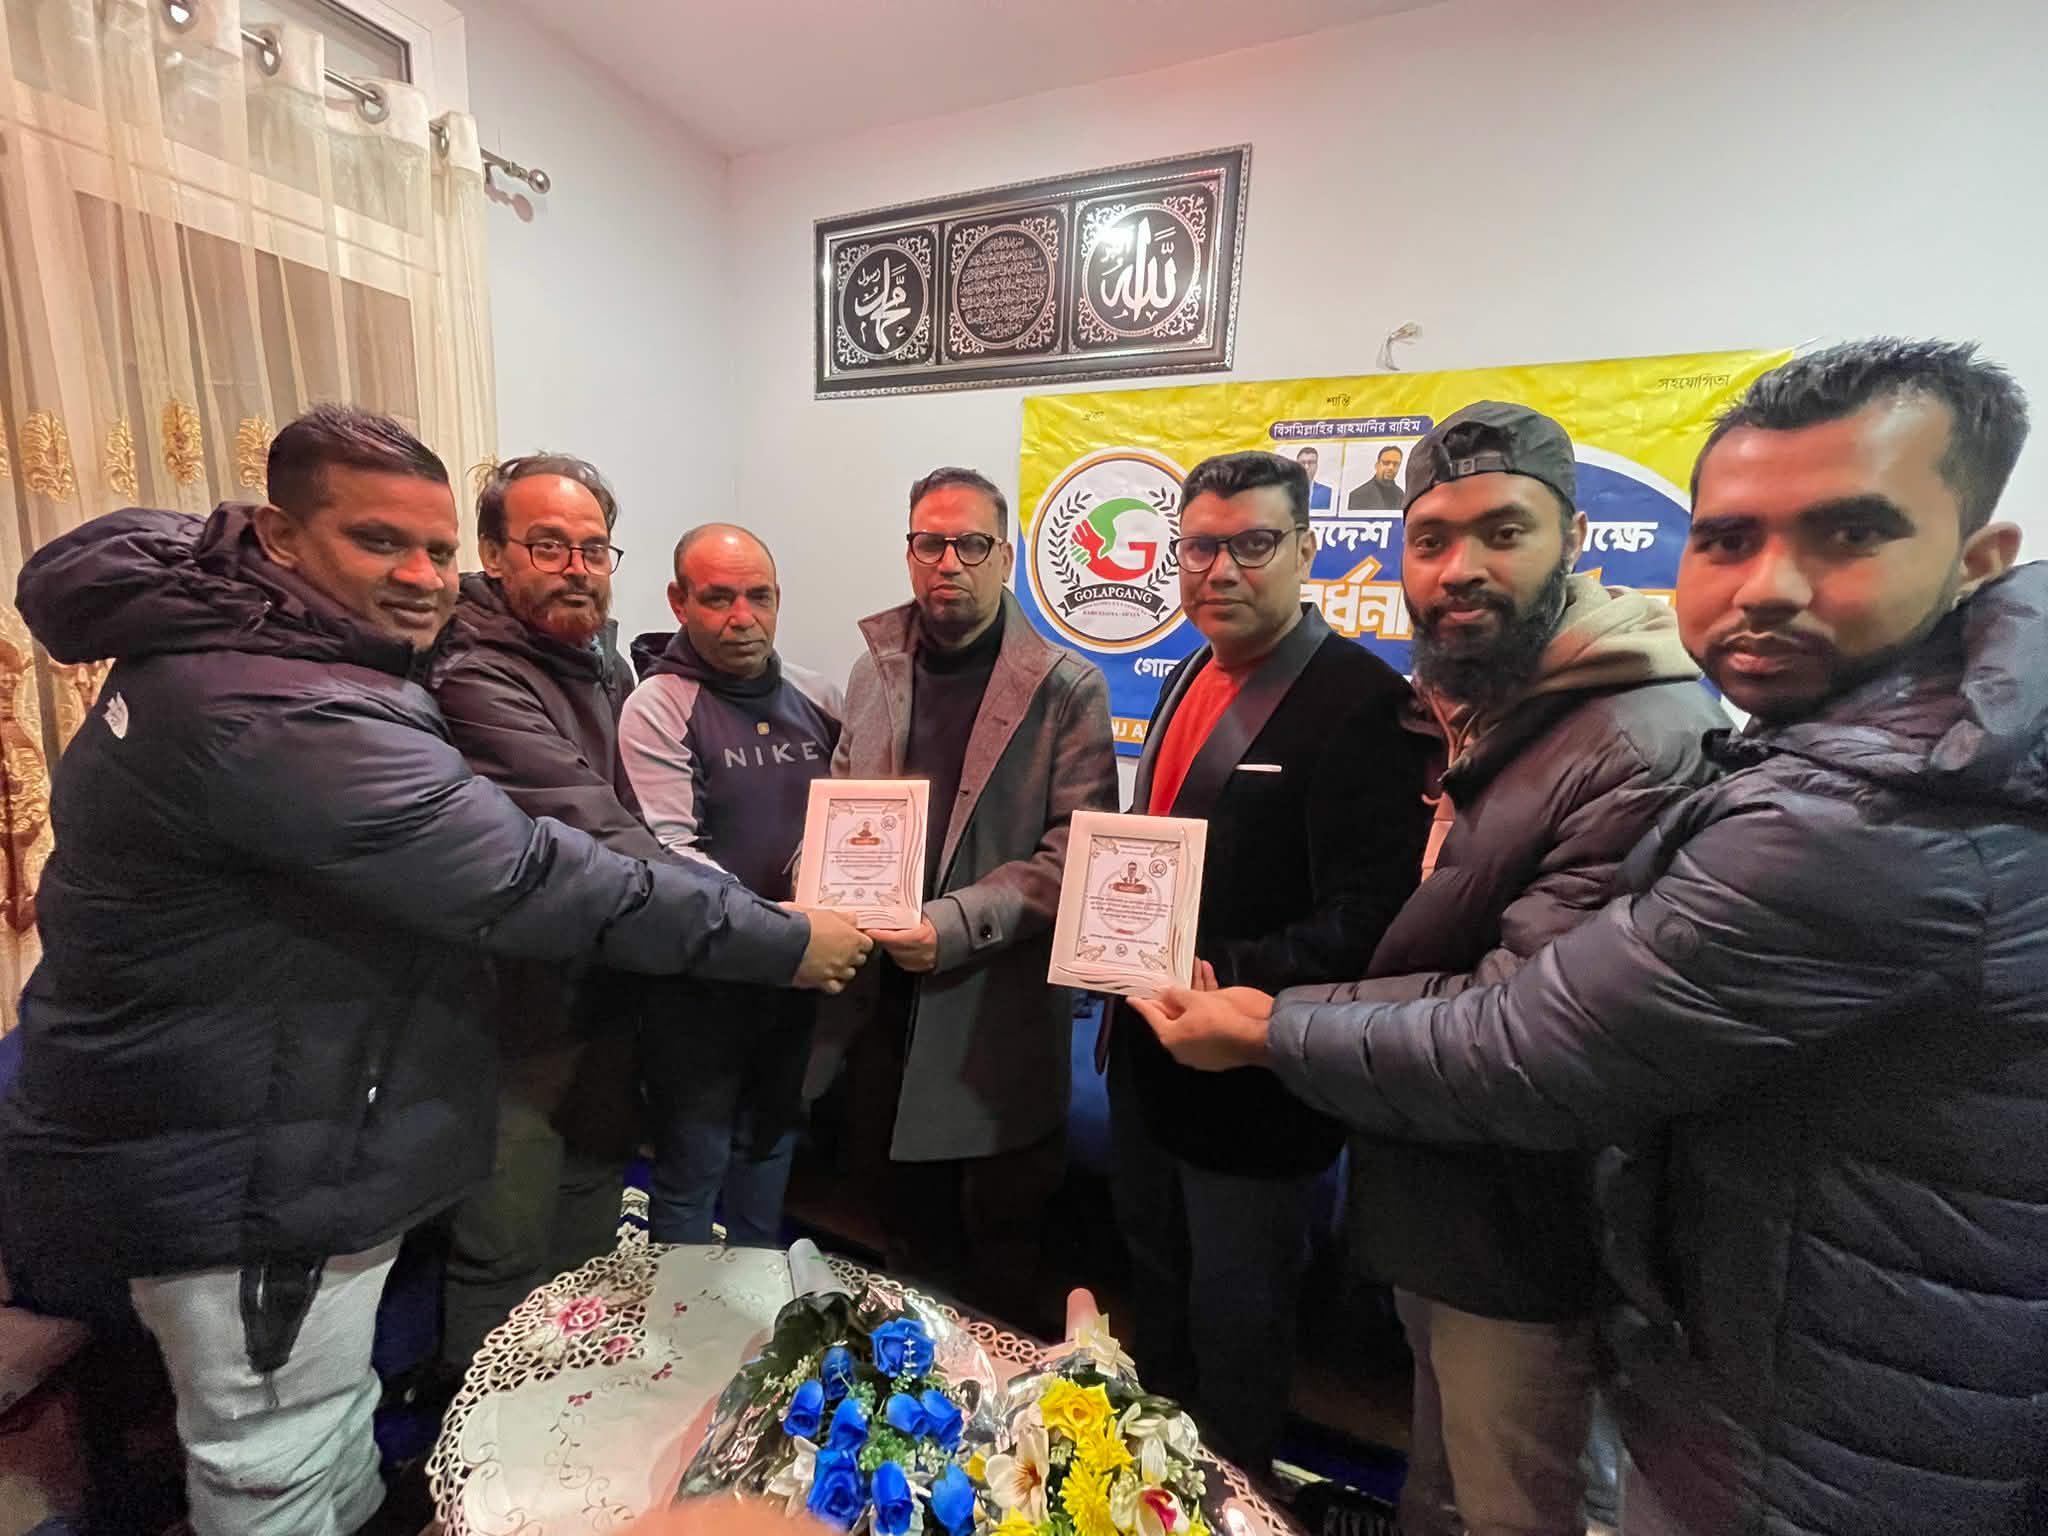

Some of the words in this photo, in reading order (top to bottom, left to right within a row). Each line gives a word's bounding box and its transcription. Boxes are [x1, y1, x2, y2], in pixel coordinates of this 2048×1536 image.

[1658, 373, 1731, 392] সহযোগিতা
[1074, 587, 1153, 604] GOLAPGANG
[724, 741, 819, 768] NIKE
